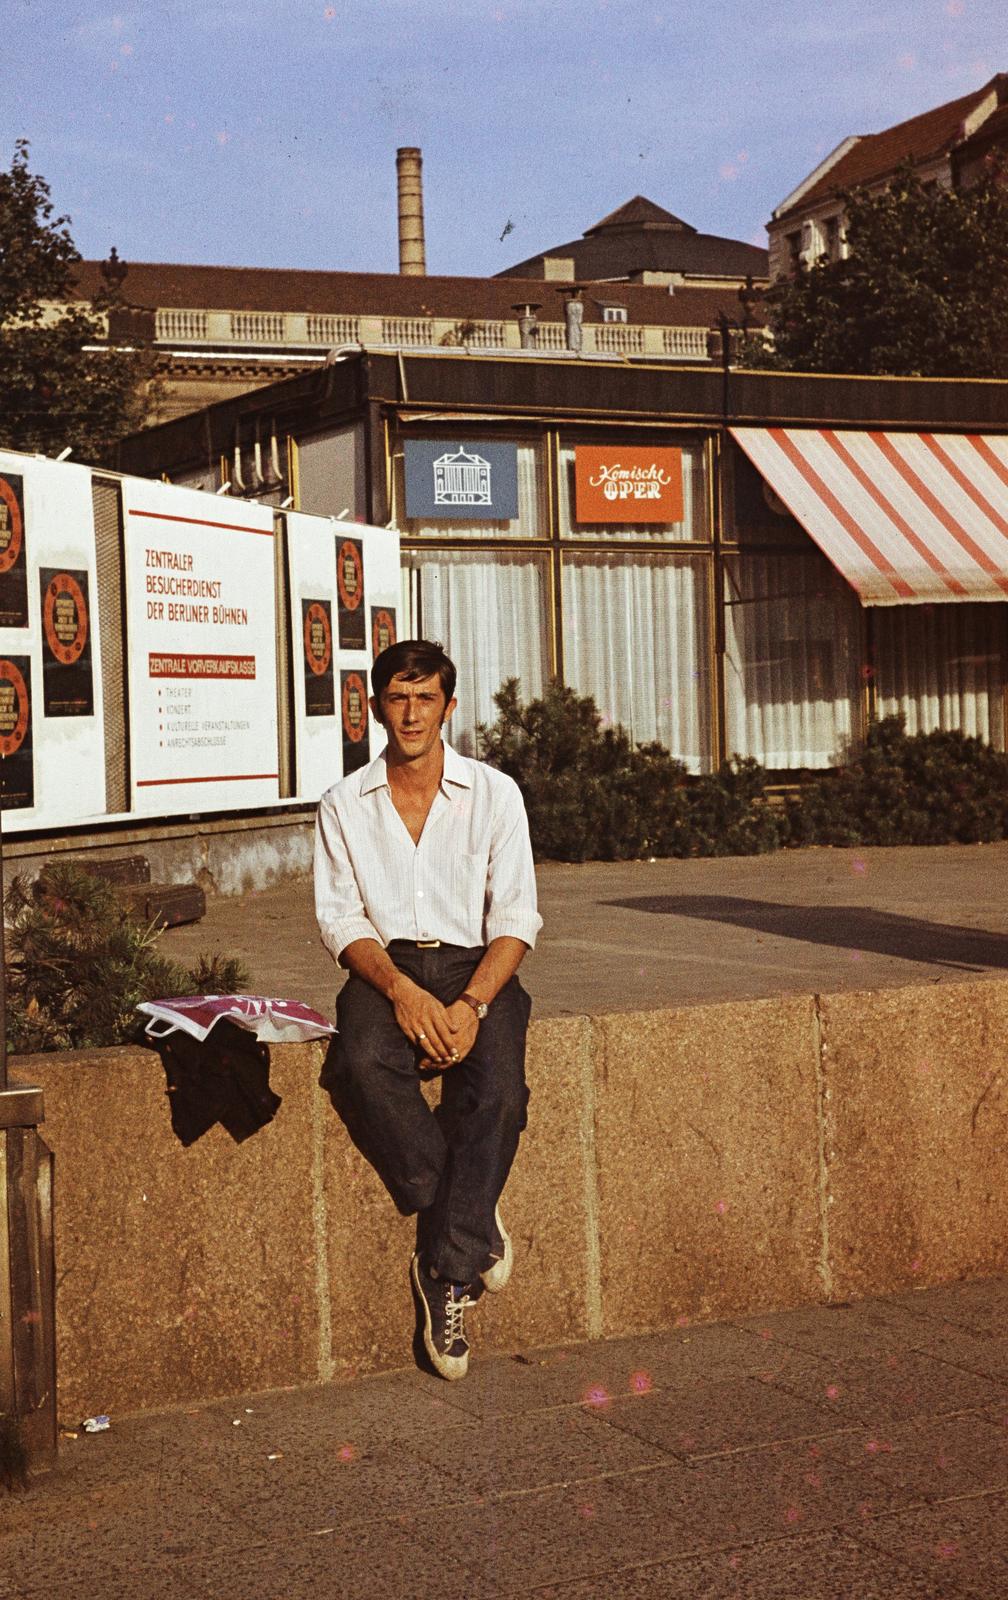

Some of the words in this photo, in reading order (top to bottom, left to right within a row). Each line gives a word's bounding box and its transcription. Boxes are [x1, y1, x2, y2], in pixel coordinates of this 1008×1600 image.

[589, 464, 671, 487] Komische
[603, 481, 661, 500] OPER
[145, 549, 193, 571] ZENTRALER
[146, 575, 221, 598] BESUCHERDIENST
[147, 601, 164, 620] DER
[168, 602, 209, 623] BERLINER
[212, 604, 248, 625] BÜHNEN
[150, 658, 186, 673] ZENTRALE
[187, 659, 255, 675] VORVERKAUFSKASSE
[166, 687, 192, 698] THEATER
